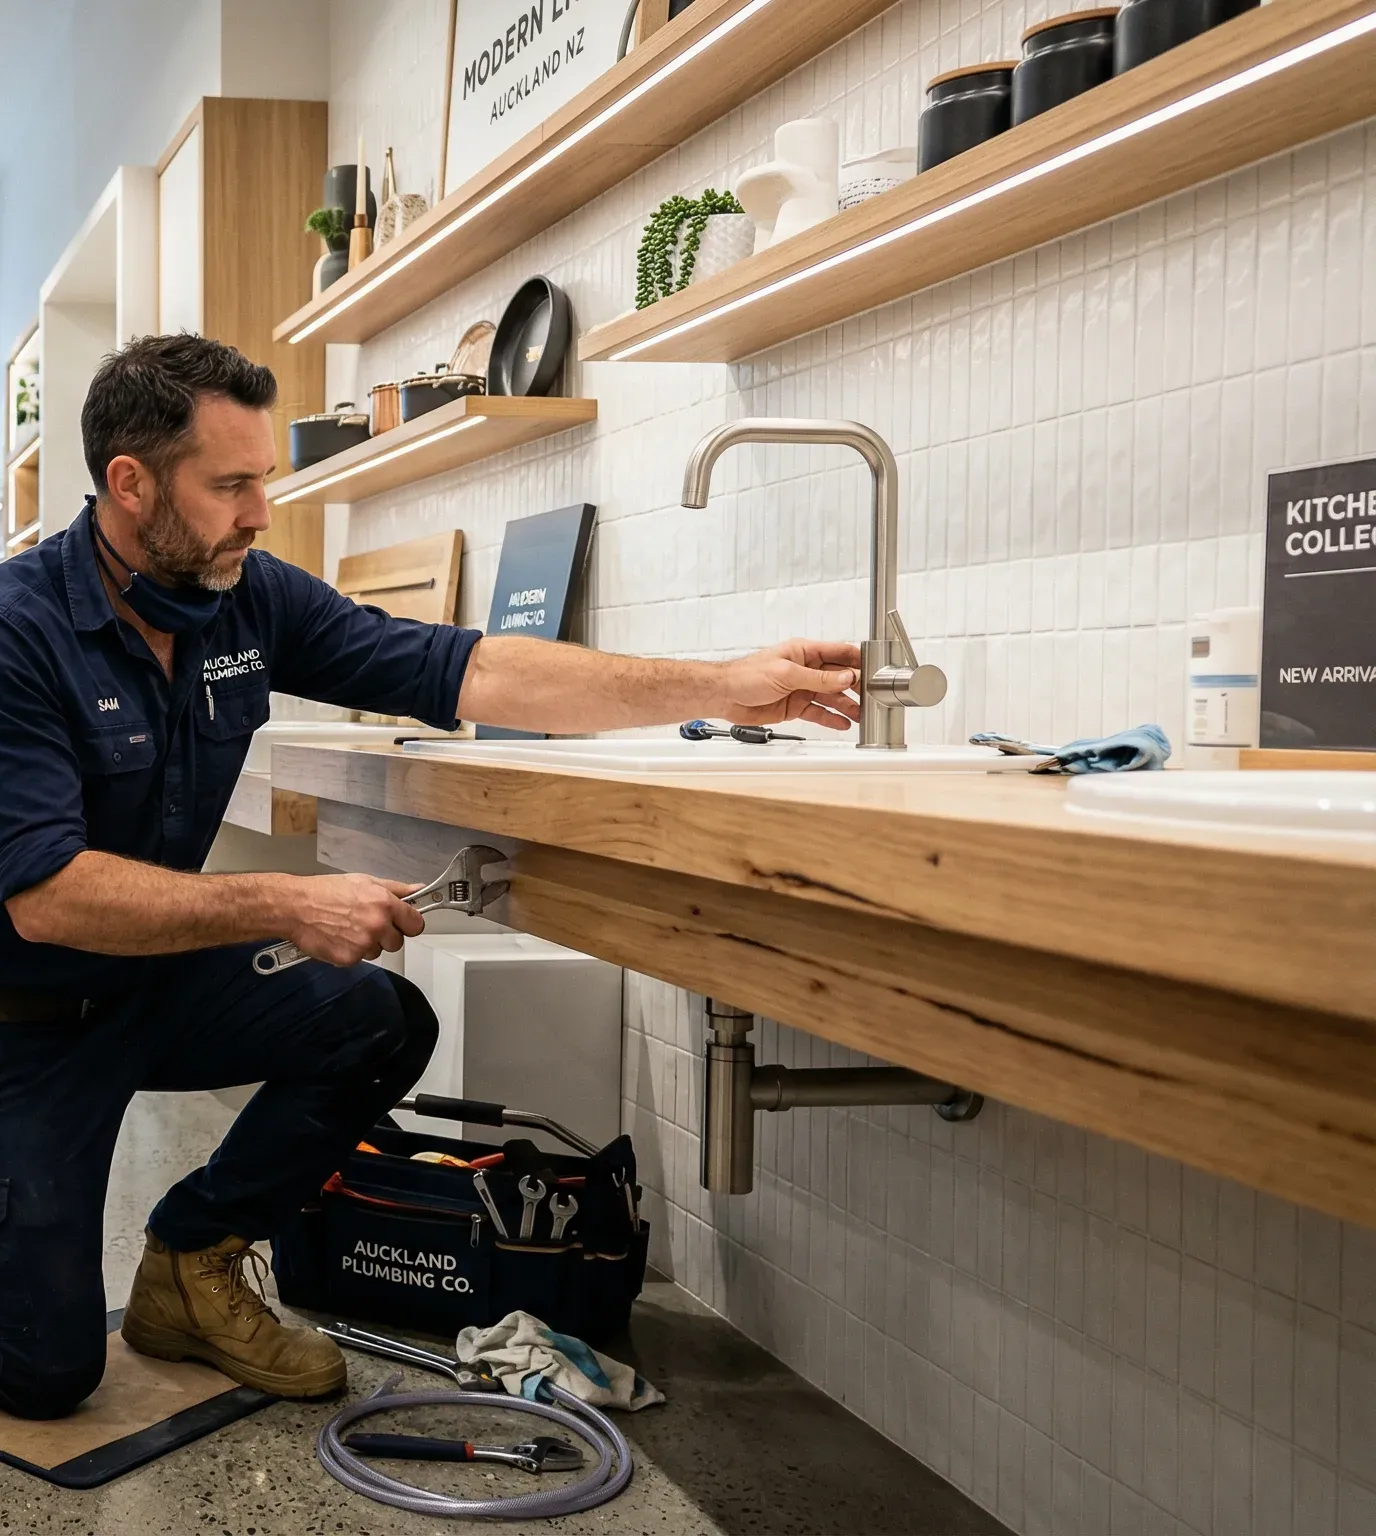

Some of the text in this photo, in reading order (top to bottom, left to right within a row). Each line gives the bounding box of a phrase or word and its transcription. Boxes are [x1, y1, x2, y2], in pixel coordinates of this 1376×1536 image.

[463, 0, 544, 100] MODERN
[489, 26, 585, 125] AUCKLAND NZ
[1285, 524, 1376, 556] COLLE
[1279, 666, 1318, 683] NEW
[97, 697, 120, 712] SAM
[354, 1239, 457, 1271] AUCKLAND
[342, 1255, 474, 1294] PLUMBING CO.
